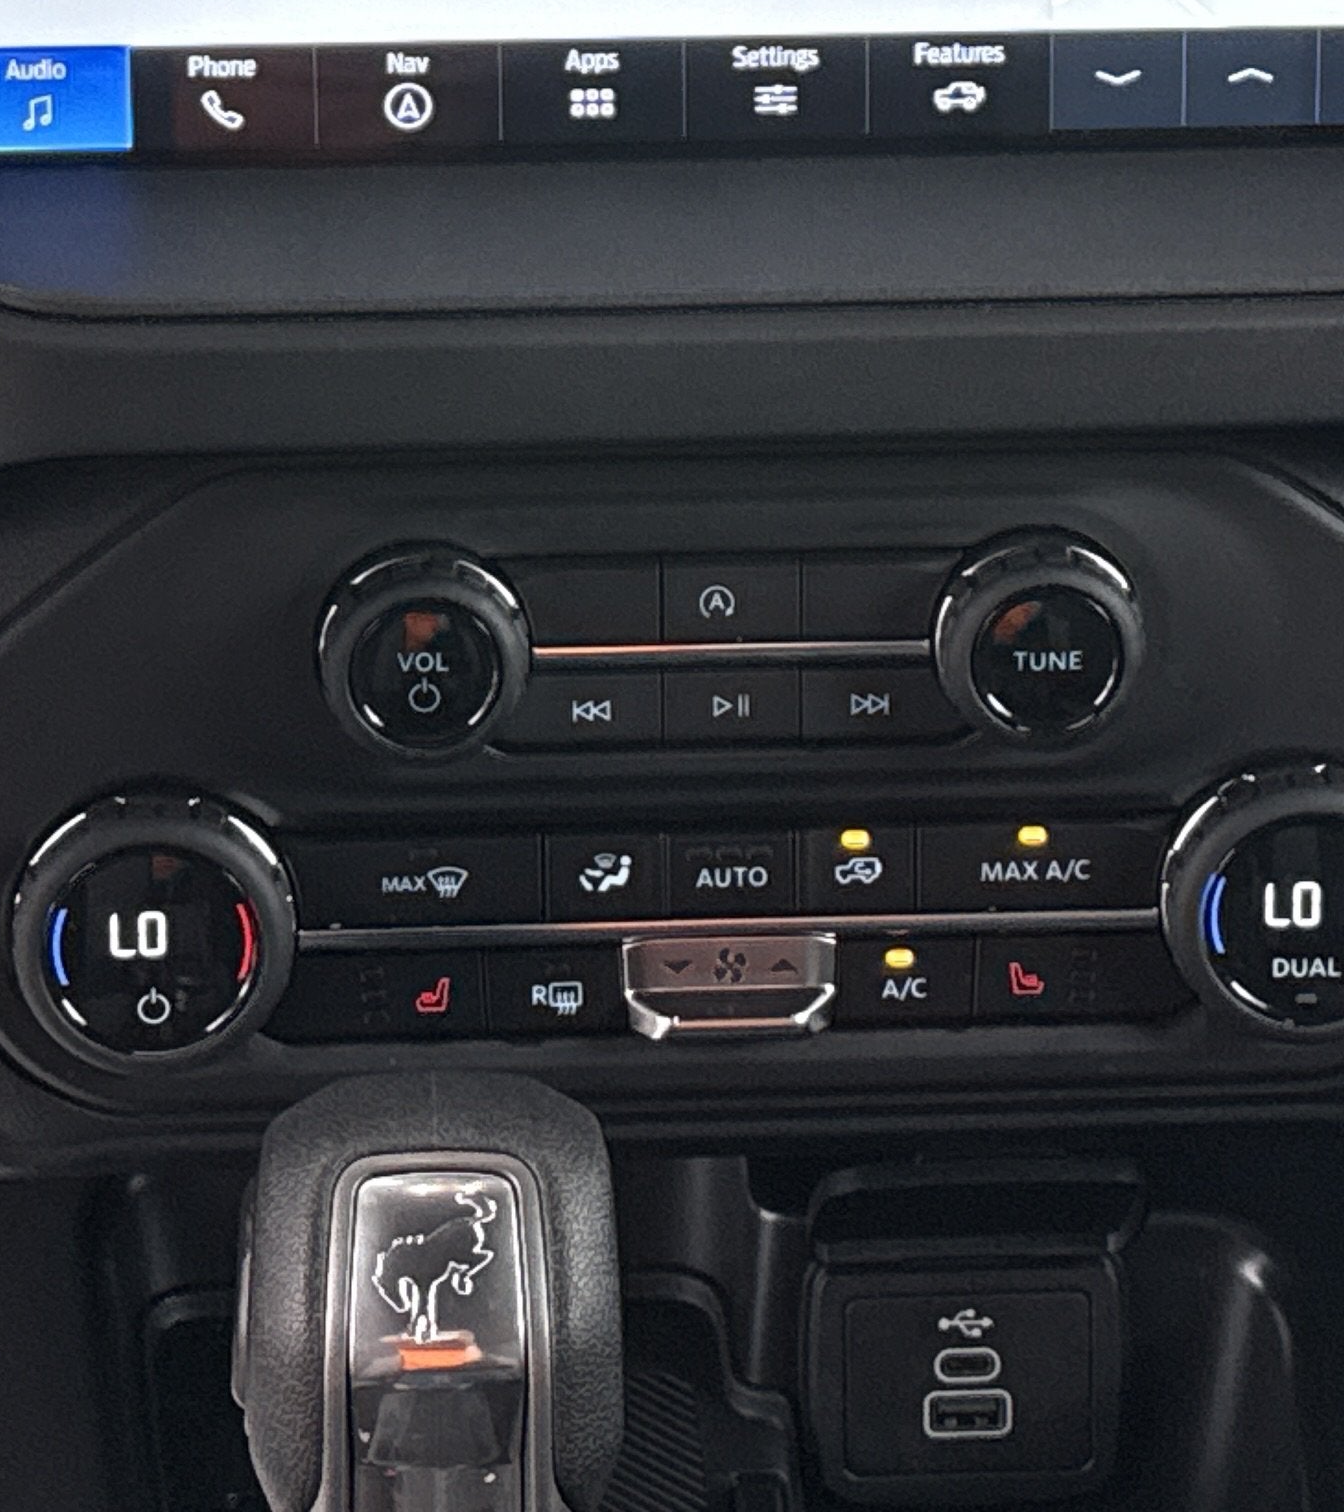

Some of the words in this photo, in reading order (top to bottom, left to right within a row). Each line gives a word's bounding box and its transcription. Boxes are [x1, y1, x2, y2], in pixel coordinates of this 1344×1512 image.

[187, 54, 257, 80] Phone
[387, 51, 430, 76] Nav
[565, 48, 621, 77] Apps
[731, 45, 820, 72] Settings
[913, 42, 1006, 67] Features
[5, 57, 67, 82] Audio
[398, 651, 450, 673] VOL
[1013, 649, 1084, 672] TUNE
[695, 866, 769, 888] AUTO
[980, 861, 1039, 883] MAX
[1045, 859, 1092, 882] A/C
[381, 876, 427, 894] MAX
[1263, 880, 1324, 929] LO
[108, 910, 169, 959] LO
[1271, 957, 1342, 978] DUAL
[881, 976, 929, 1001] A/C
